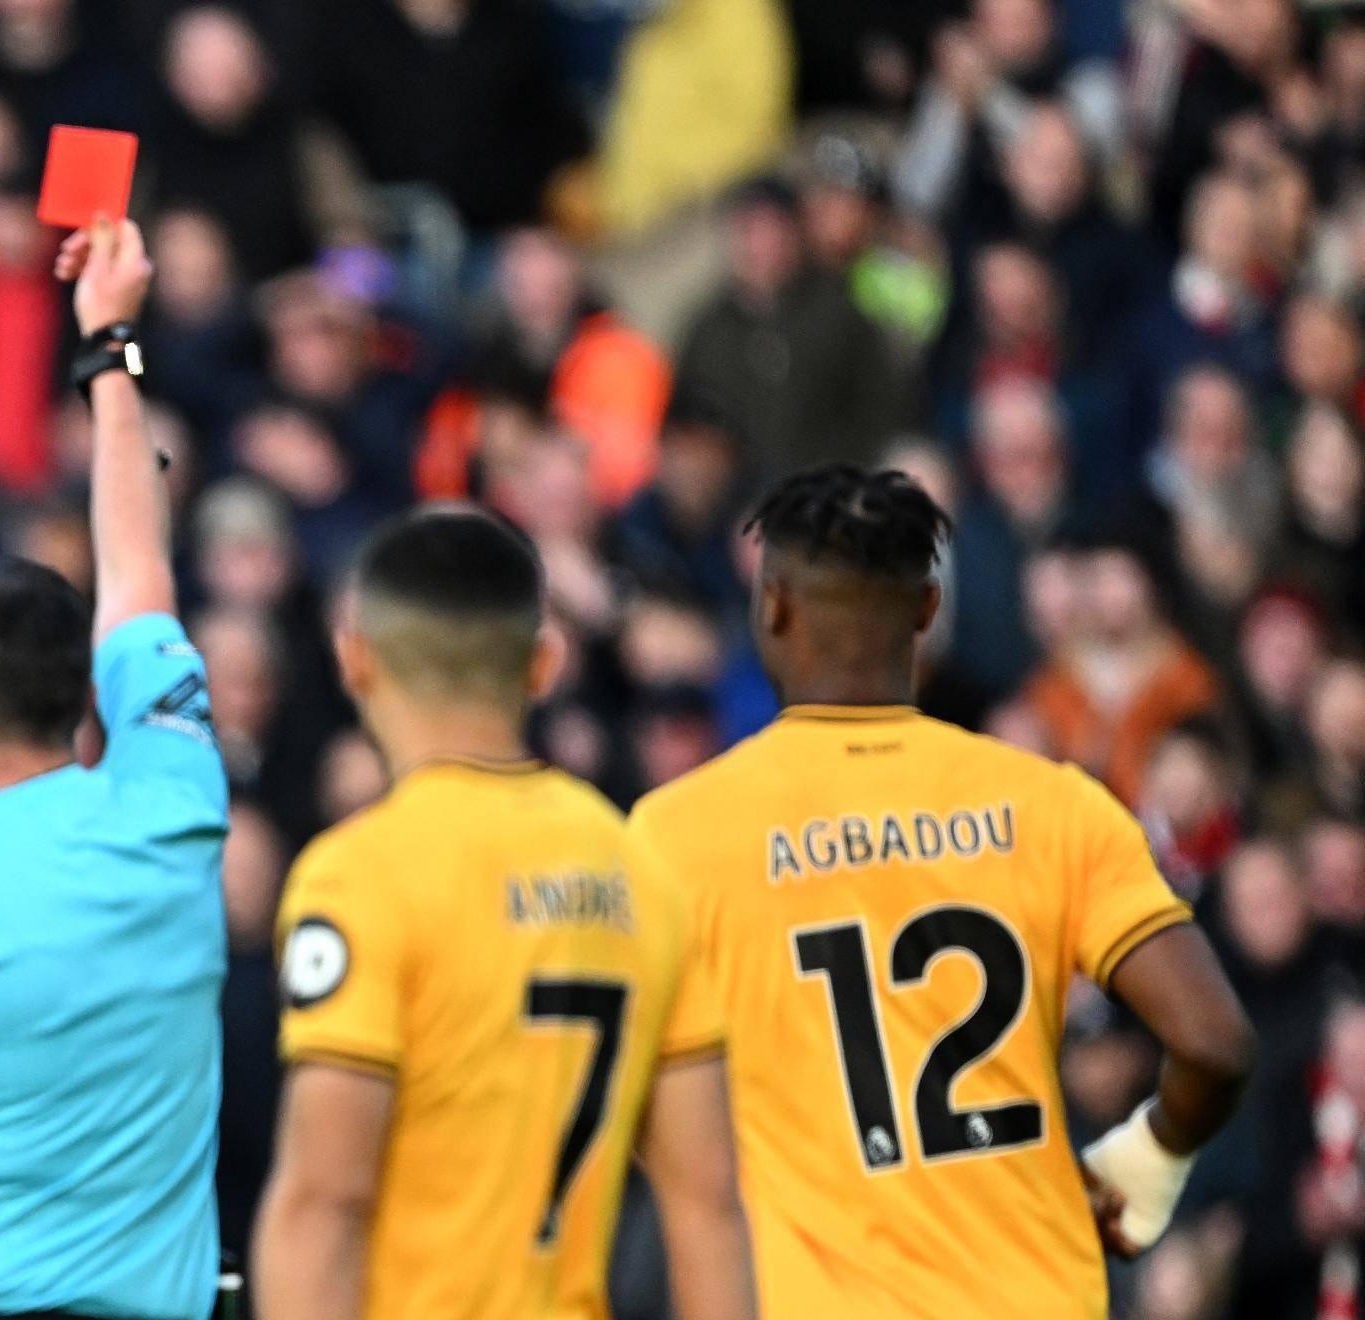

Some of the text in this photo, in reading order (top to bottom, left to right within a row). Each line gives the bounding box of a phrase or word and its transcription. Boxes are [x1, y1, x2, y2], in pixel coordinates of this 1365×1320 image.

[770, 802, 1015, 882] AGBADOU
[524, 972, 630, 1253] 7
[793, 904, 1046, 1174] 12
